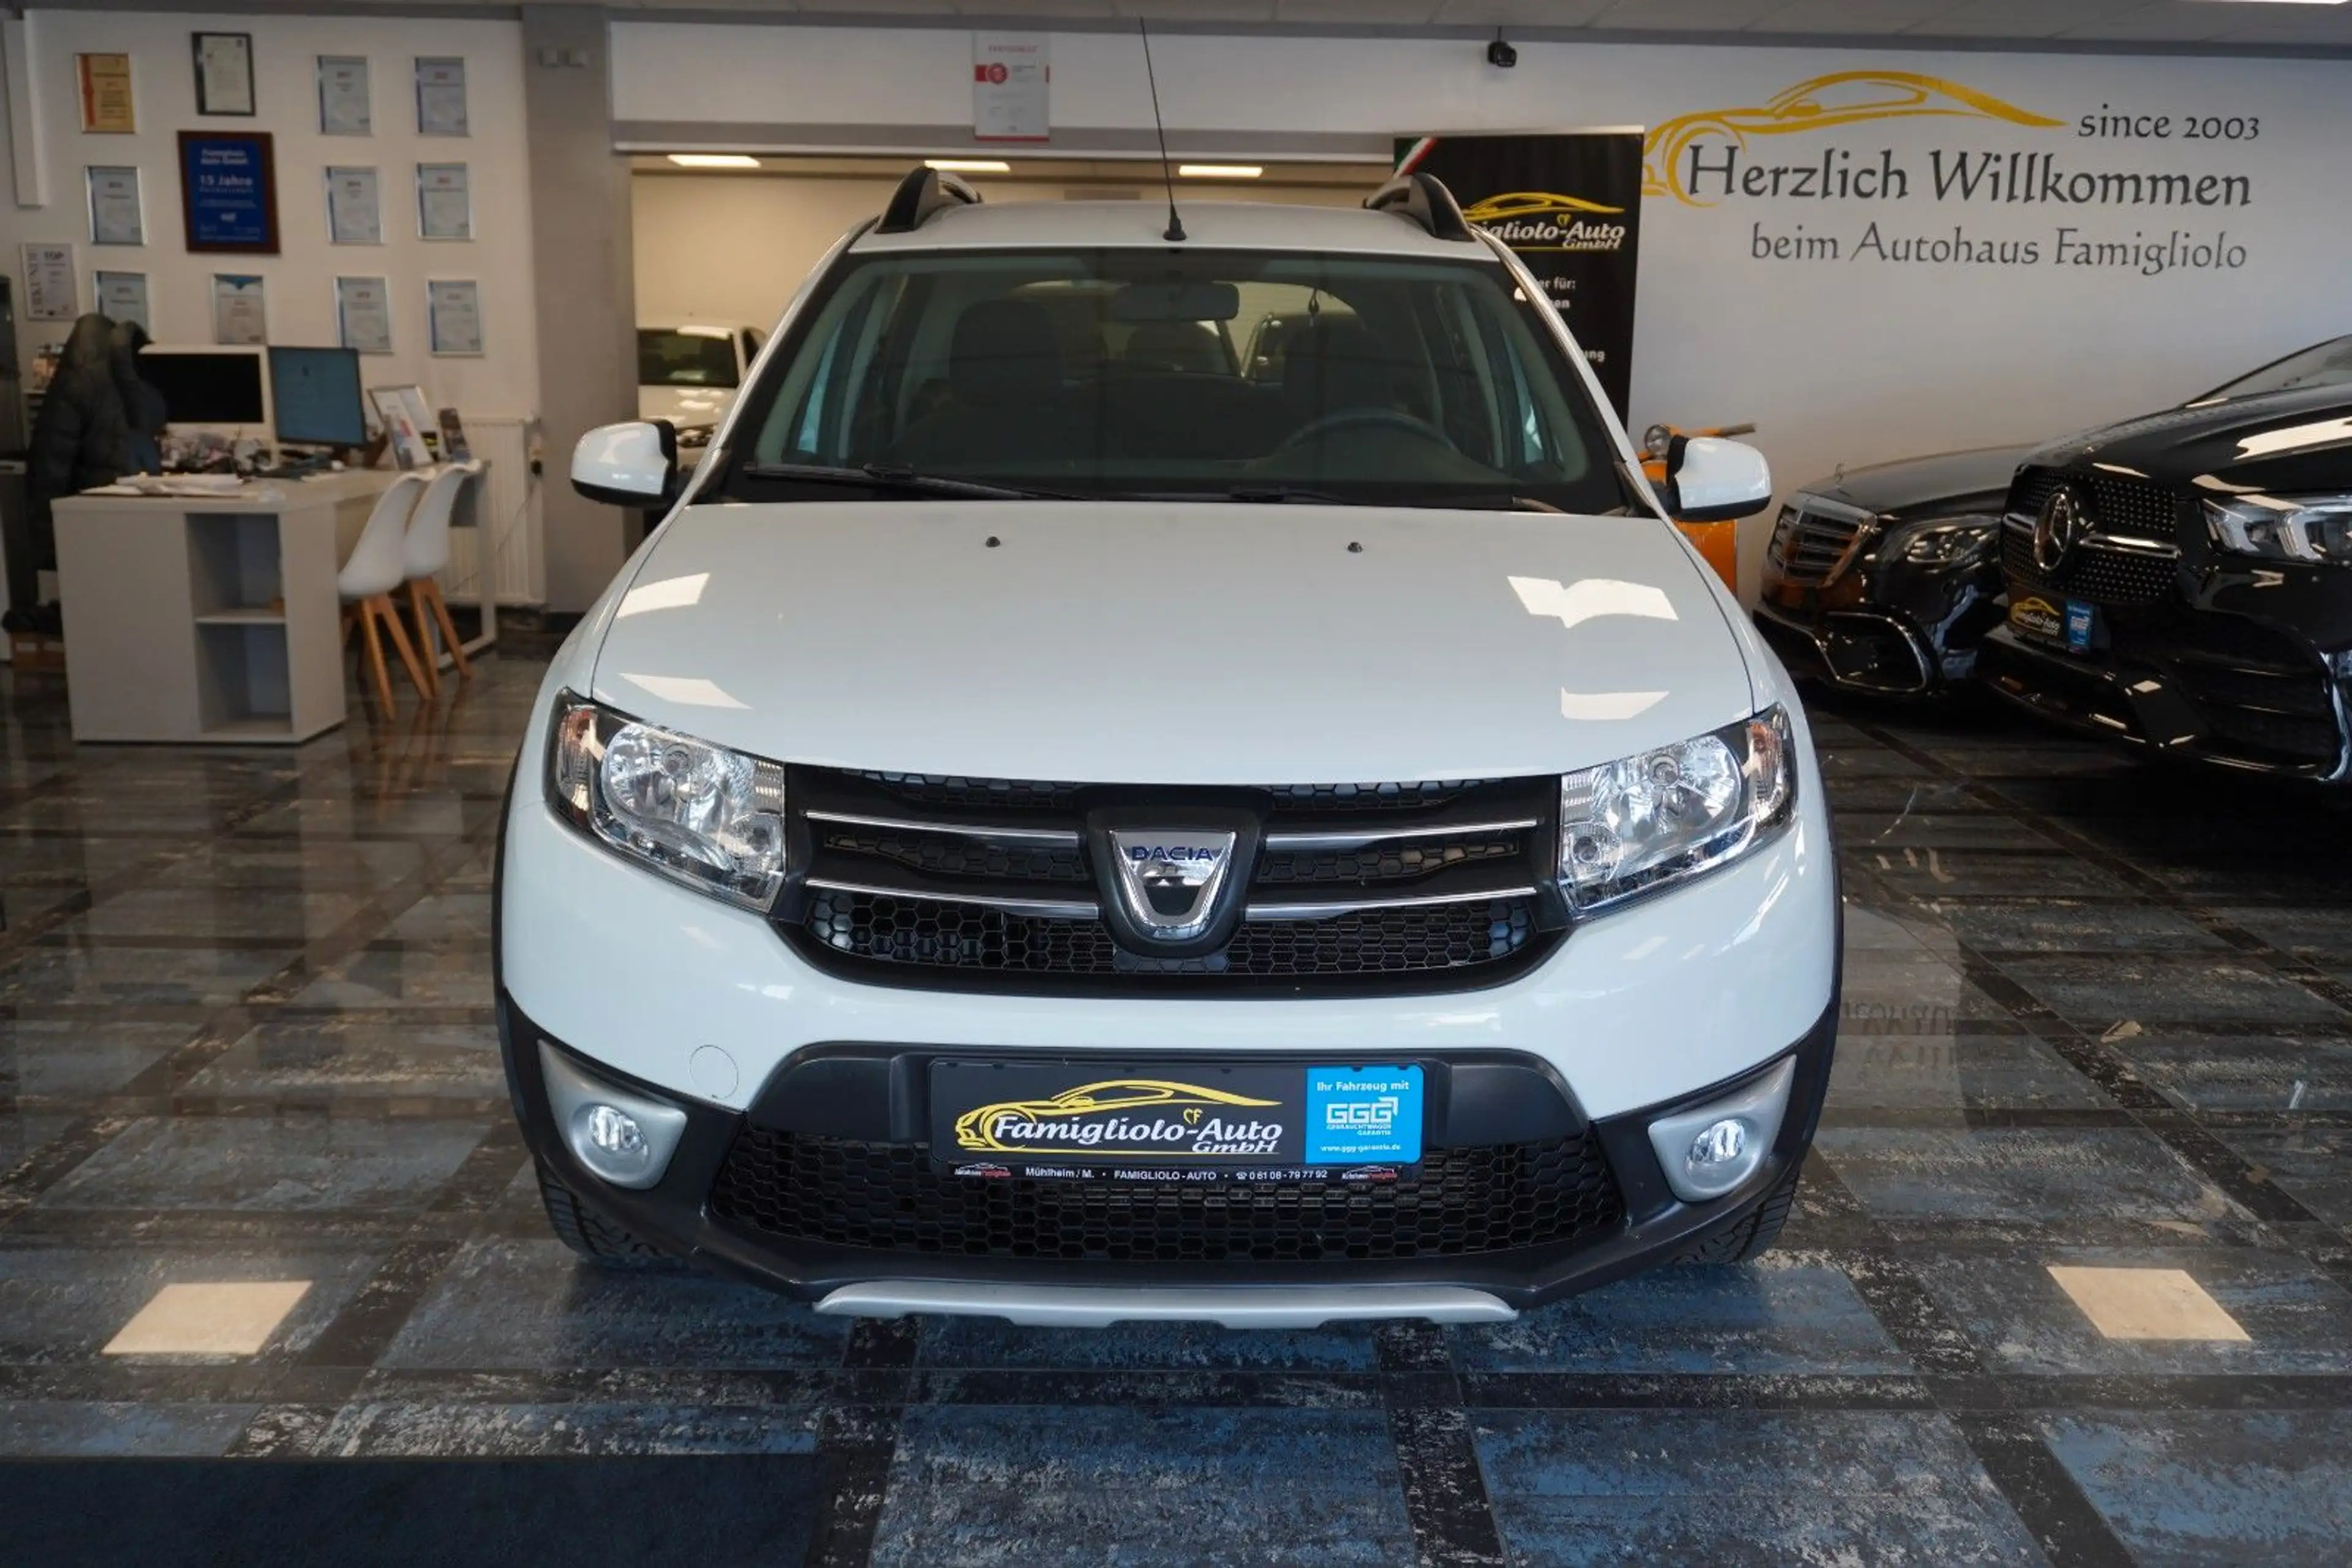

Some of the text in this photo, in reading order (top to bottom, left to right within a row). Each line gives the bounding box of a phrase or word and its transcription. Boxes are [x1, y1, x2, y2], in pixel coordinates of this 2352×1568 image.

[2078, 103, 2260, 140] since 2003
[1688, 145, 2252, 206] Herzlich Willkommen
[1476, 221, 1626, 240] igliolo-Auto
[1751, 221, 2247, 276] beim Autohaus Famigliolo
[1131, 846, 1213, 861] DACIA
[1317, 1080, 1409, 1092] Ihr Fahrzeug mit
[1326, 1102, 1392, 1124] GGG
[994, 1115, 1283, 1144] Famigliolo-Auto
[1191, 1140, 1279, 1153] GmbH
